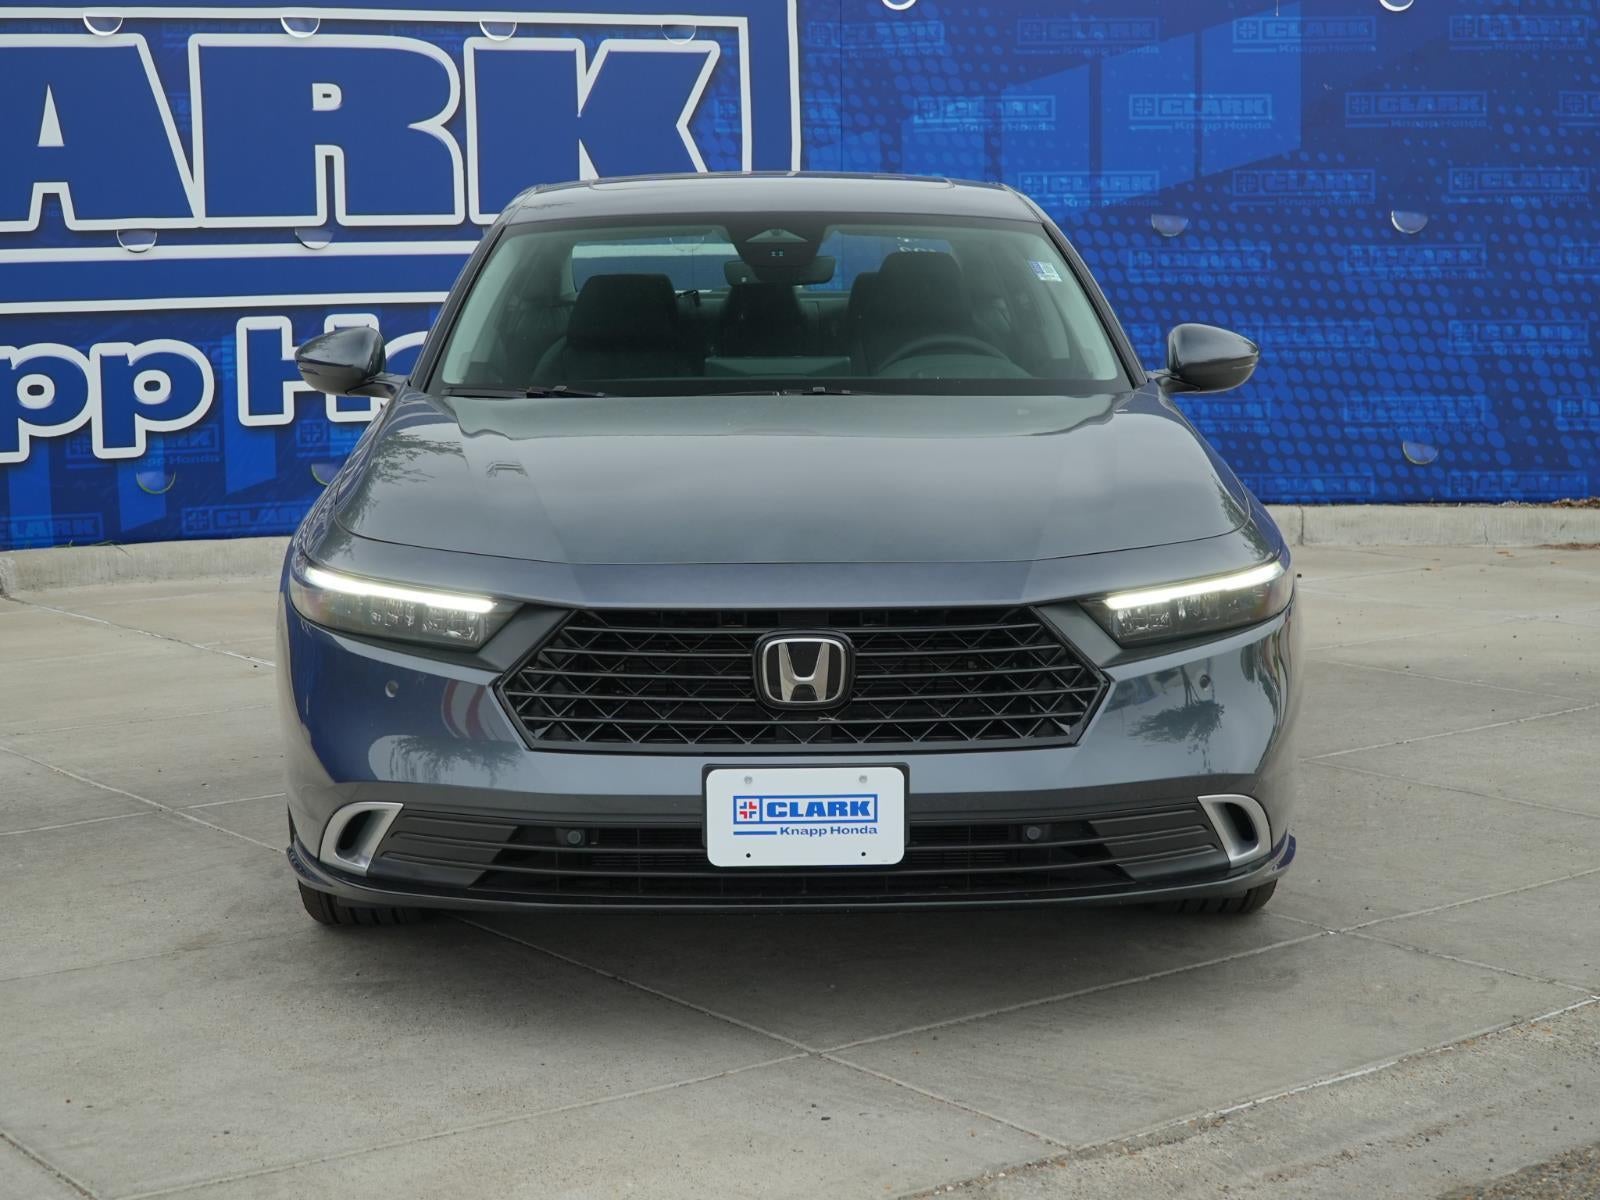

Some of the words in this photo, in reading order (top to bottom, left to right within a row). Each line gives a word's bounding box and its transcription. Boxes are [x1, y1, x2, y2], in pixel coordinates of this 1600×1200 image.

[766, 801, 871, 818] CLARK
[779, 826, 827, 837] Knapp
[829, 825, 878, 835] Honda
